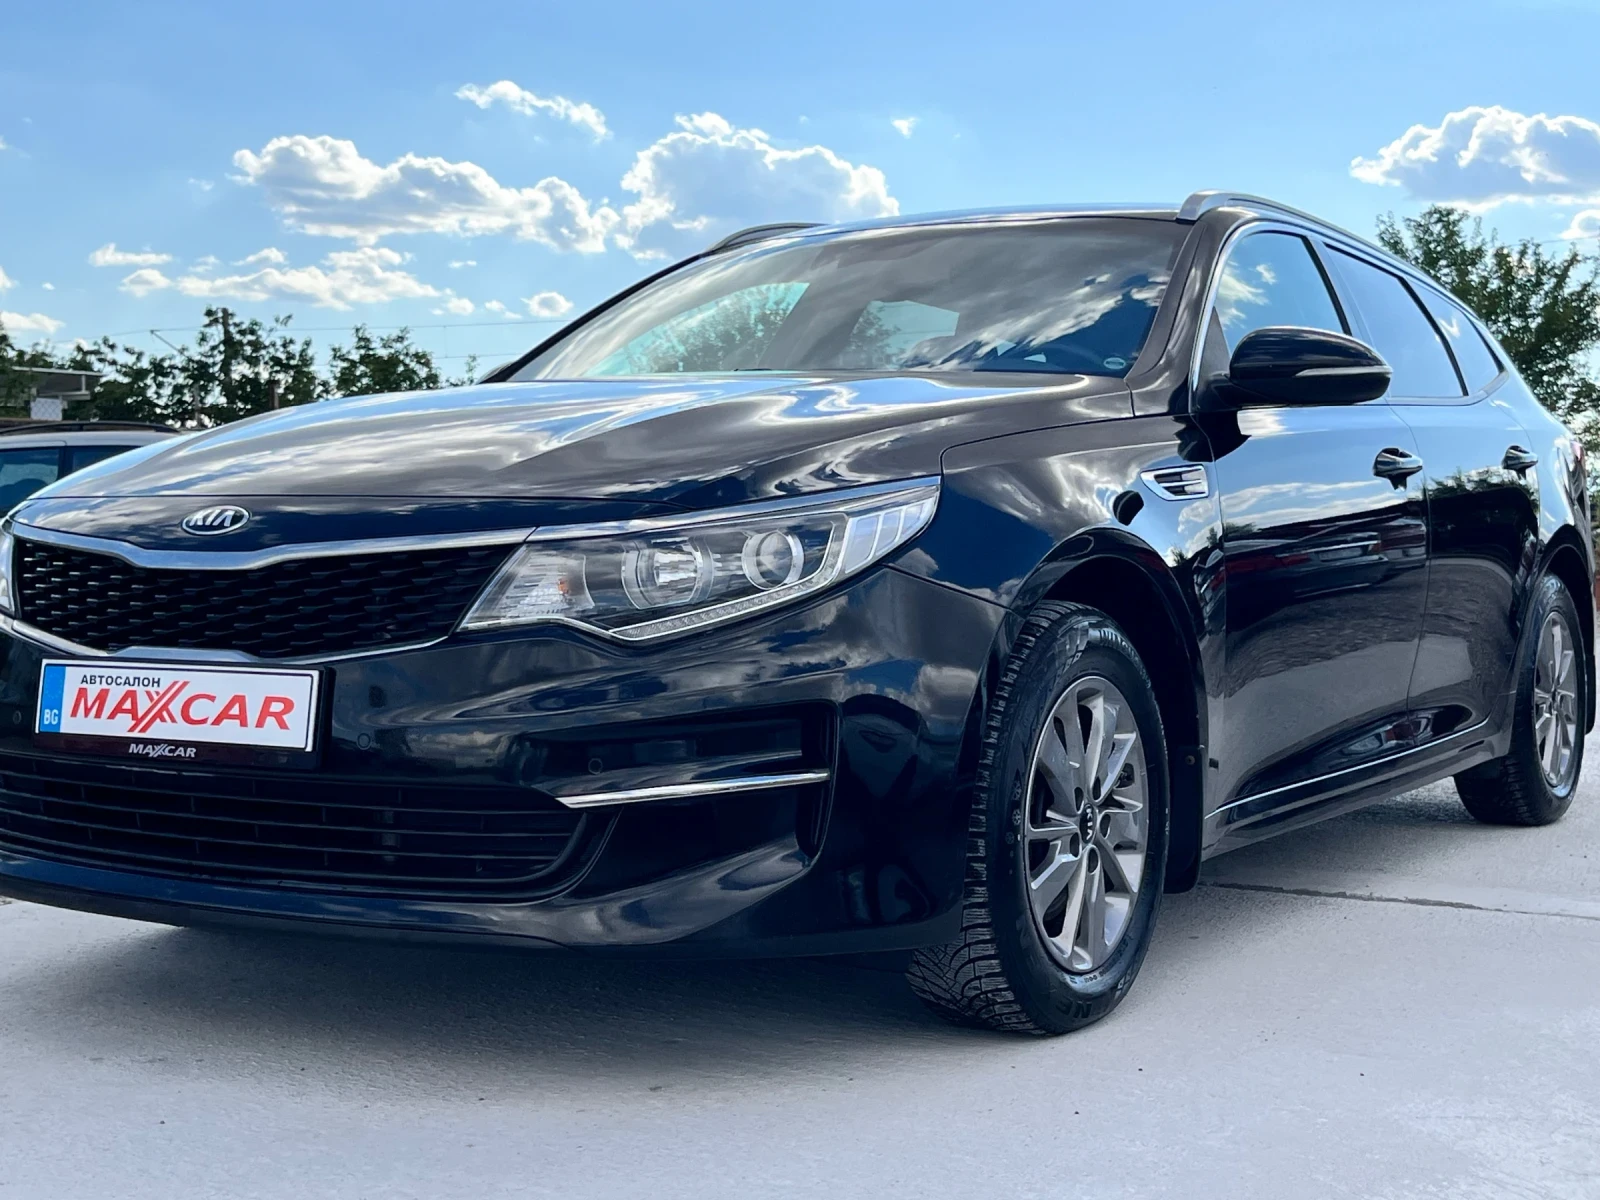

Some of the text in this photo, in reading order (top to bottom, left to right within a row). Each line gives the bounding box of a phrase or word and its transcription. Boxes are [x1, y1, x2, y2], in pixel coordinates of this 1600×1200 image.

[188, 508, 236, 527] KIA
[80, 674, 161, 688] АВТОСАЛОН
[70, 680, 295, 733] MAXCAR
[43, 708, 59, 725] BG
